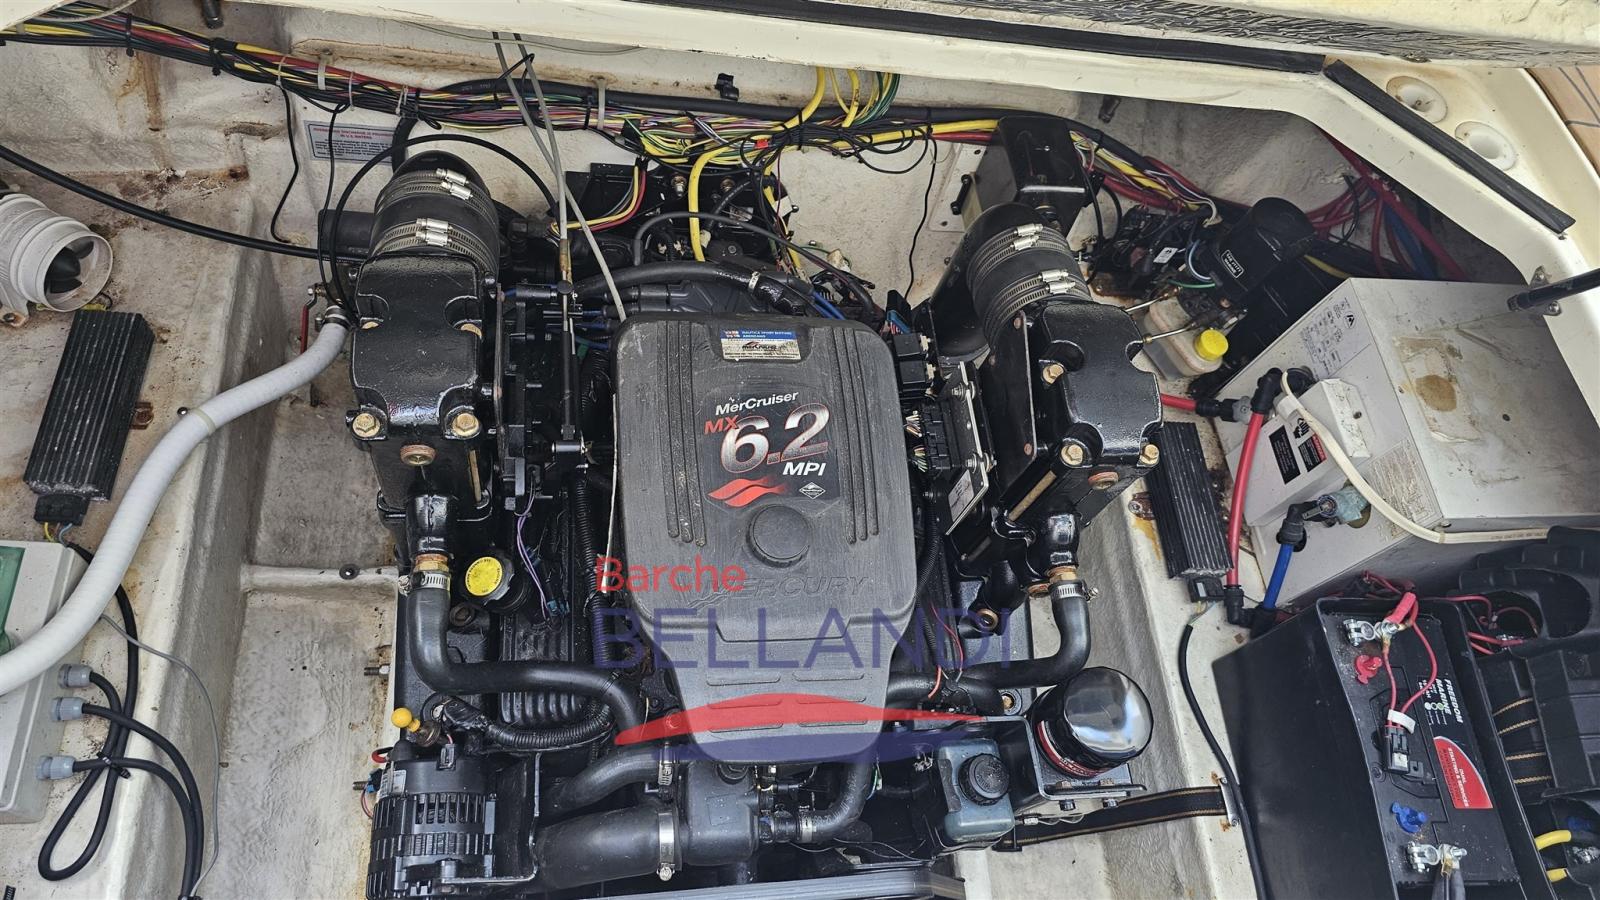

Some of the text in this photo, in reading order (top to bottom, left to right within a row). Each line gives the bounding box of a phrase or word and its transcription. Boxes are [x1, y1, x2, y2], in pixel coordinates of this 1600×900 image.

[715, 391, 799, 416] MerCruiser
[704, 414, 739, 435] MX
[720, 402, 830, 474] 6.2
[782, 461, 827, 477] MPI
[1435, 678, 1452, 716] MARINE
[1444, 678, 1464, 724] FREEDOM
